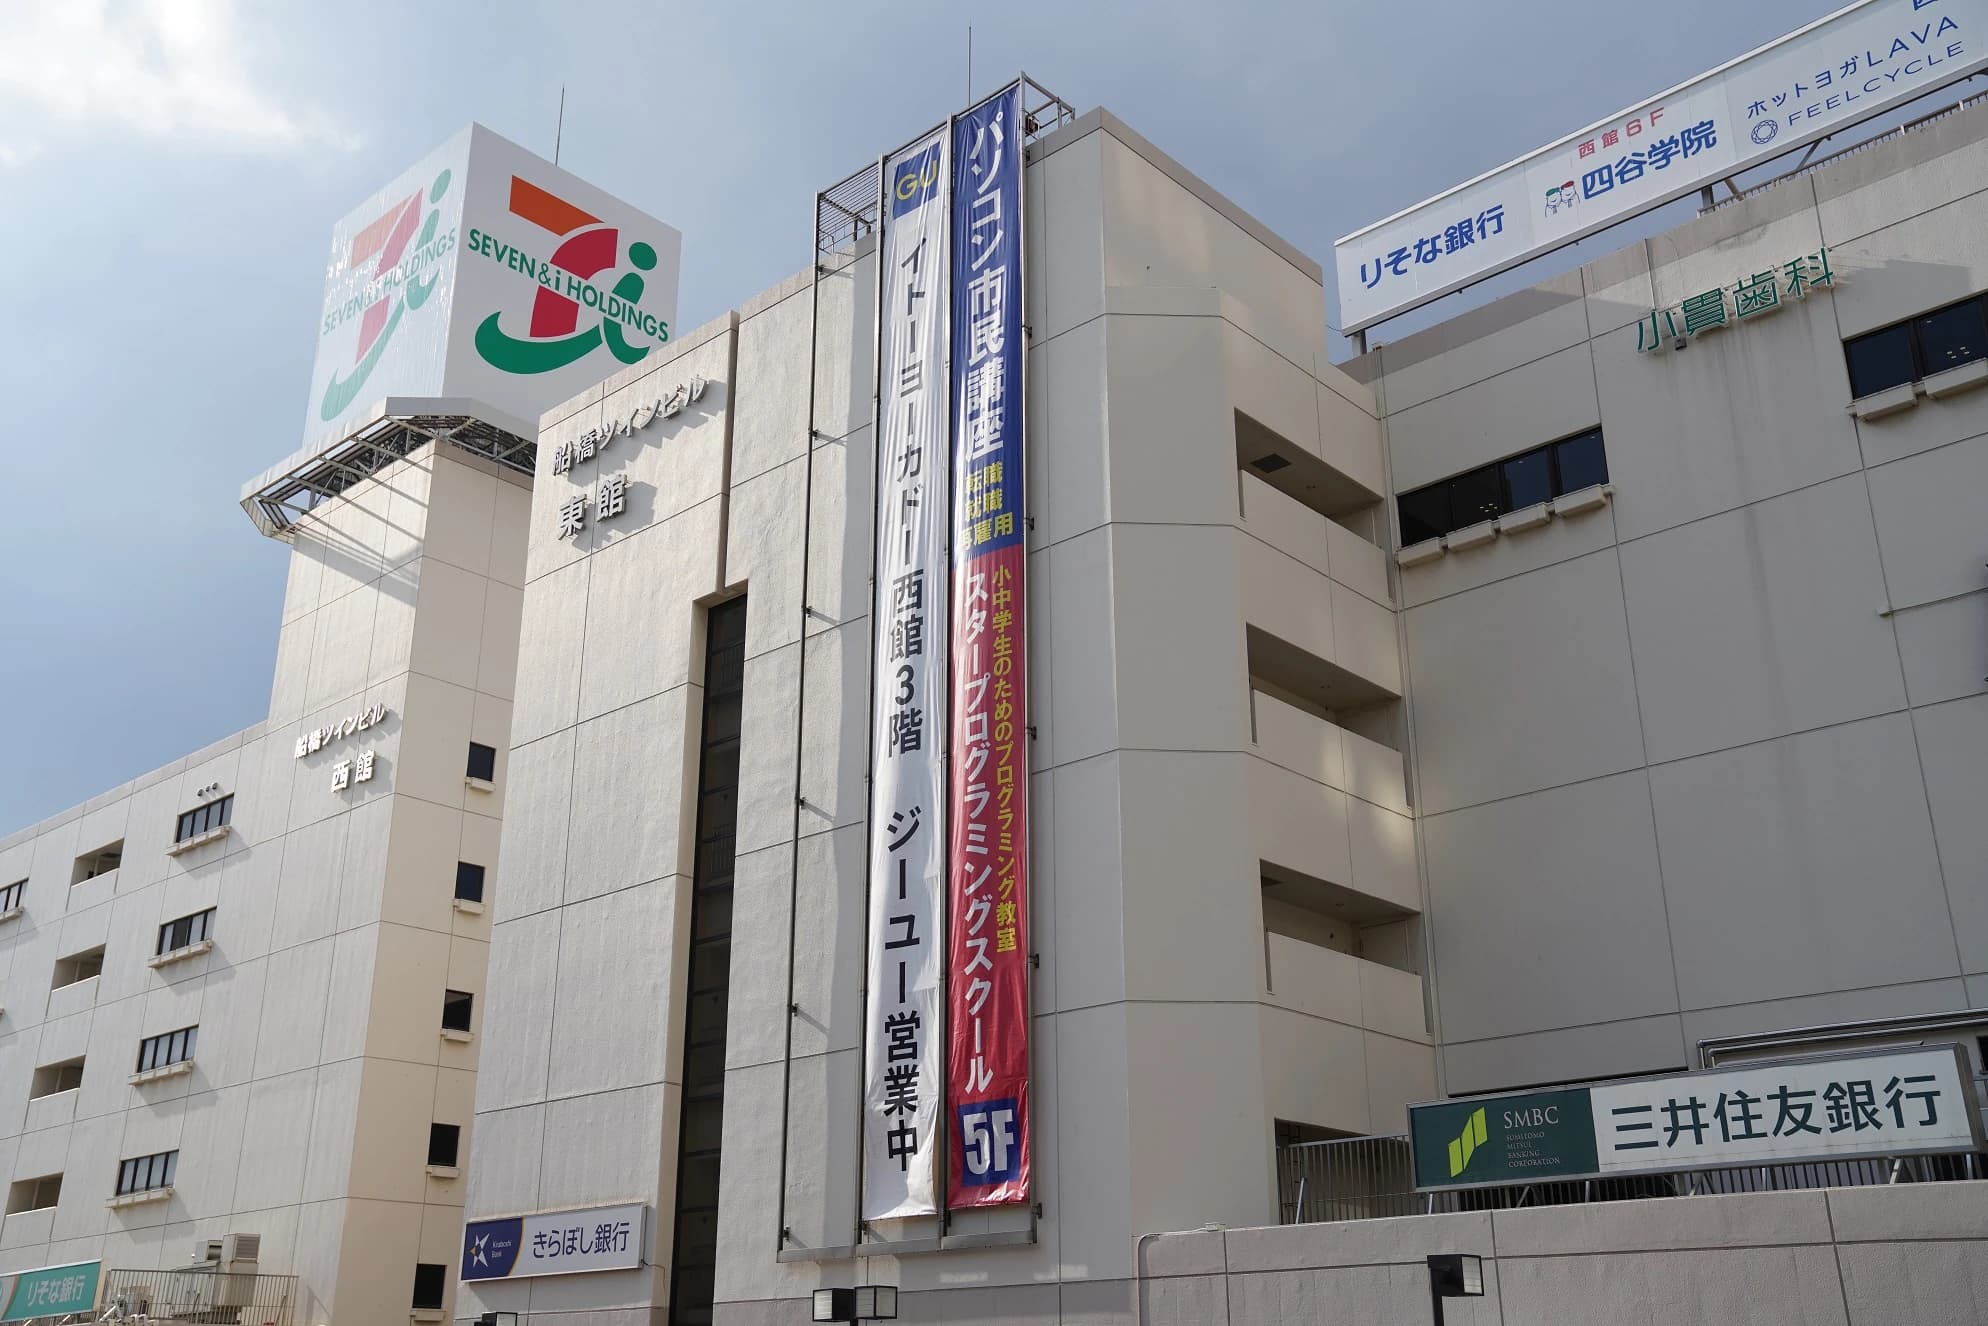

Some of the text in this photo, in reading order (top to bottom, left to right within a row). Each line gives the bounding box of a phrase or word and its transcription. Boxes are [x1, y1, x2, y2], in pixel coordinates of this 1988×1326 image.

[1788, 41, 1964, 126] FEELCYCLE
[896, 159, 937, 201] GU
[1582, 119, 1717, 200] 四谷学院
[1360, 203, 1505, 289] りそな銀行
[566, 280, 669, 343] HOLDINGS
[966, 111, 1005, 461] パソコン市民講座
[1637, 247, 1834, 352] 小貫歯科
[553, 374, 707, 476] 船橋ツインビル
[558, 474, 629, 541] 東館
[294, 703, 385, 759] 船橋ツインビル
[991, 564, 1017, 953] 小中学生のためのプログラミング教室
[330, 749, 375, 793] 西館
[964, 571, 993, 1095] スタープログラミングスクール
[884, 806, 921, 1171] ジーユー営業中
[963, 1107, 1015, 1175] 5F
[1503, 1106, 1559, 1129] SMBC
[1611, 1075, 1941, 1152] 三井住友銀行
[533, 1221, 630, 1259] きらぼし銀行
[27, 1275, 87, 1308] りそな銀行
